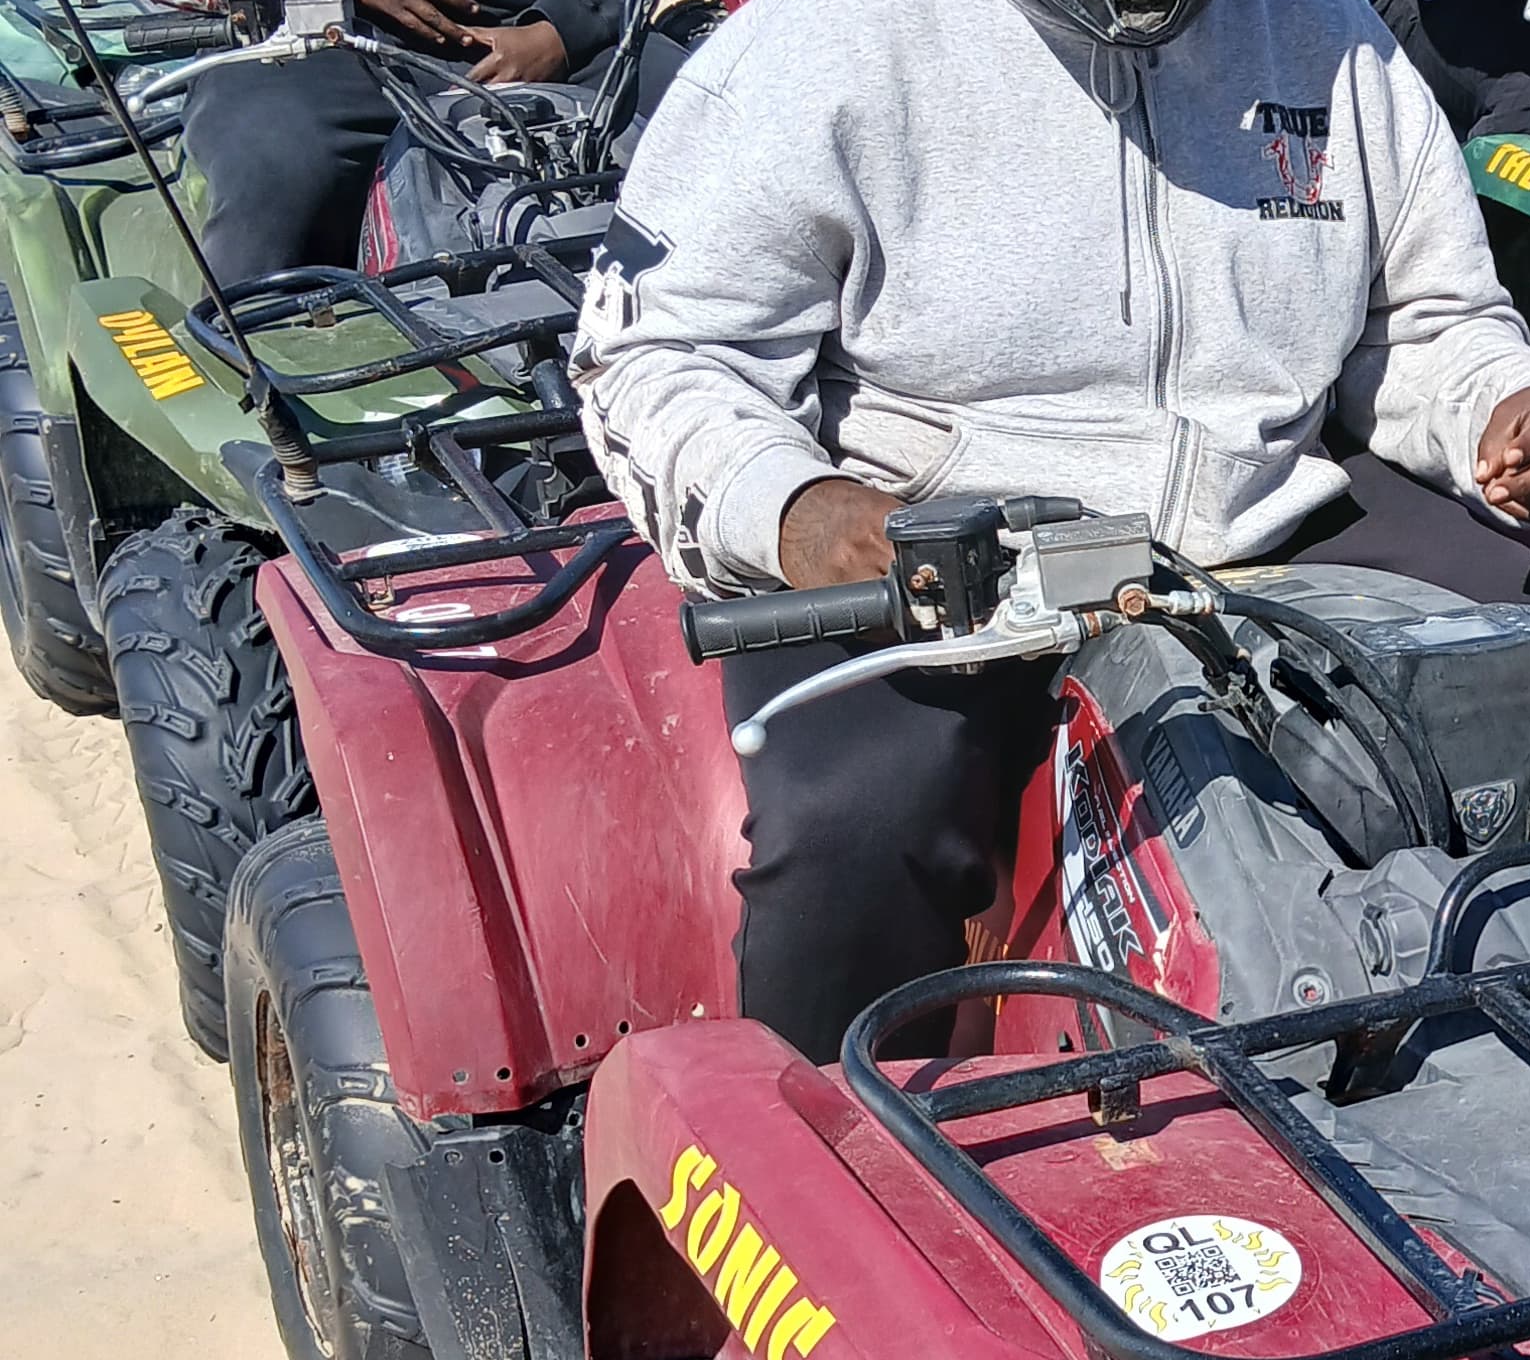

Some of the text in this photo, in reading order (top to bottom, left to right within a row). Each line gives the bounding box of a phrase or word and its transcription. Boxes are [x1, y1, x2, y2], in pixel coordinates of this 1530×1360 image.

[1242, 99, 1331, 138] TRUE
[1256, 196, 1346, 222] RELIGION
[98, 310, 206, 401] DYLAN
[1146, 731, 1201, 842] YAMAHA
[1065, 740, 1146, 967] KODIAK
[1143, 1226, 1215, 1254] QL
[1179, 1283, 1255, 1322] 107
